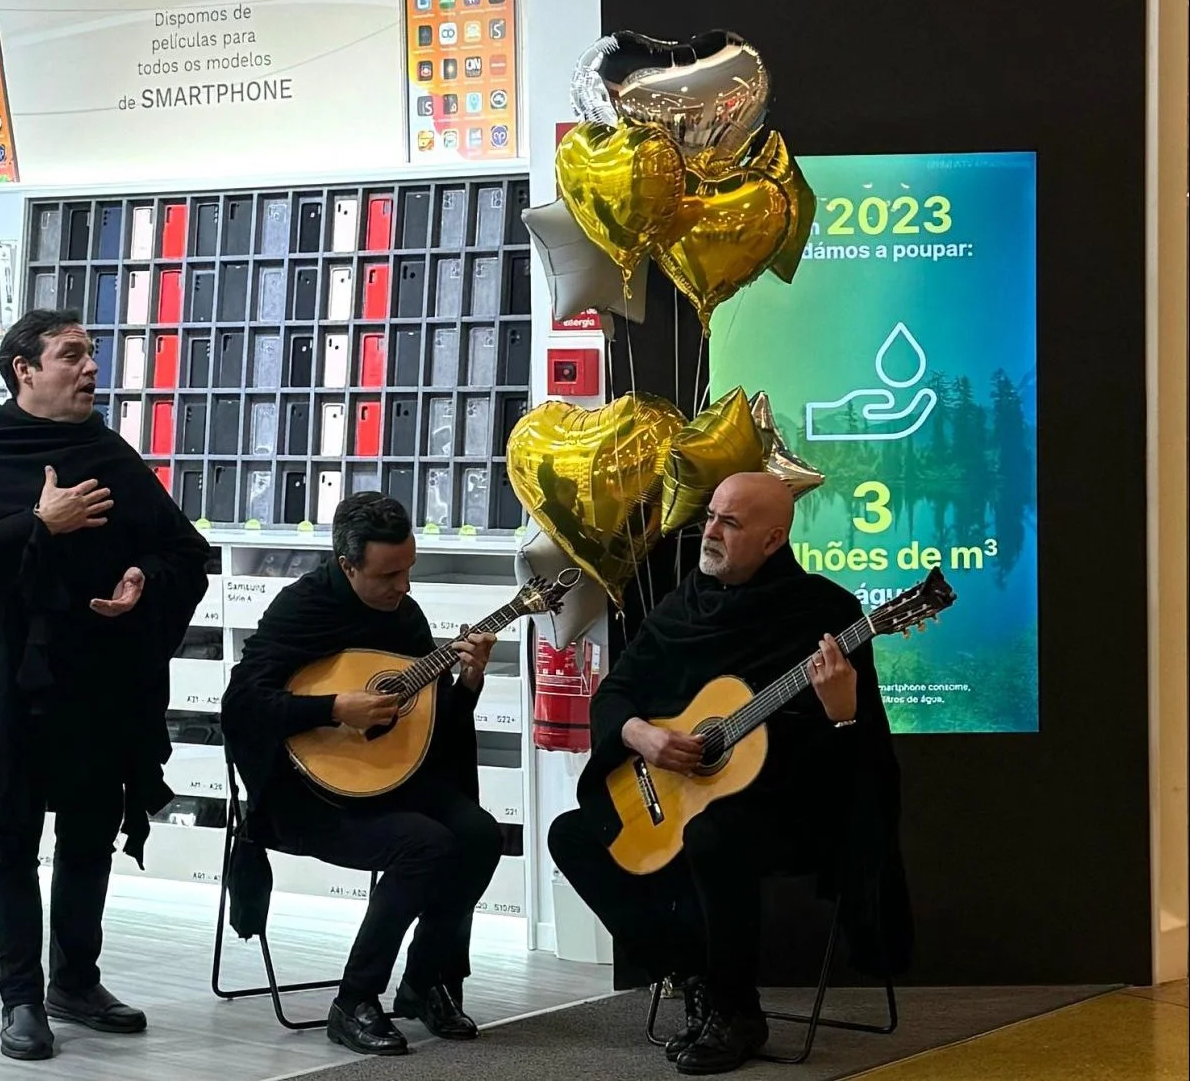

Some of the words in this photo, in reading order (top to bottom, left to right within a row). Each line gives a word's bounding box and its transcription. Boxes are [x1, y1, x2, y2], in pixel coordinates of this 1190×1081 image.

[154, 8, 227, 28] Dispomos
[233, 5, 252, 21] de
[151, 33, 218, 53] películas
[223, 31, 256, 48] para
[138, 59, 178, 76] todos
[184, 60, 202, 72] os
[207, 52, 272, 70] modelos
[118, 95, 136, 111] de
[141, 78, 293, 109] SMARTPHONE
[826, 195, 953, 235] 2023
[876, 245, 887, 259] a
[893, 243, 974, 262] poupar:
[853, 481, 893, 534] 3
[897, 541, 942, 570] de
[227, 582, 266, 594] Samsung
